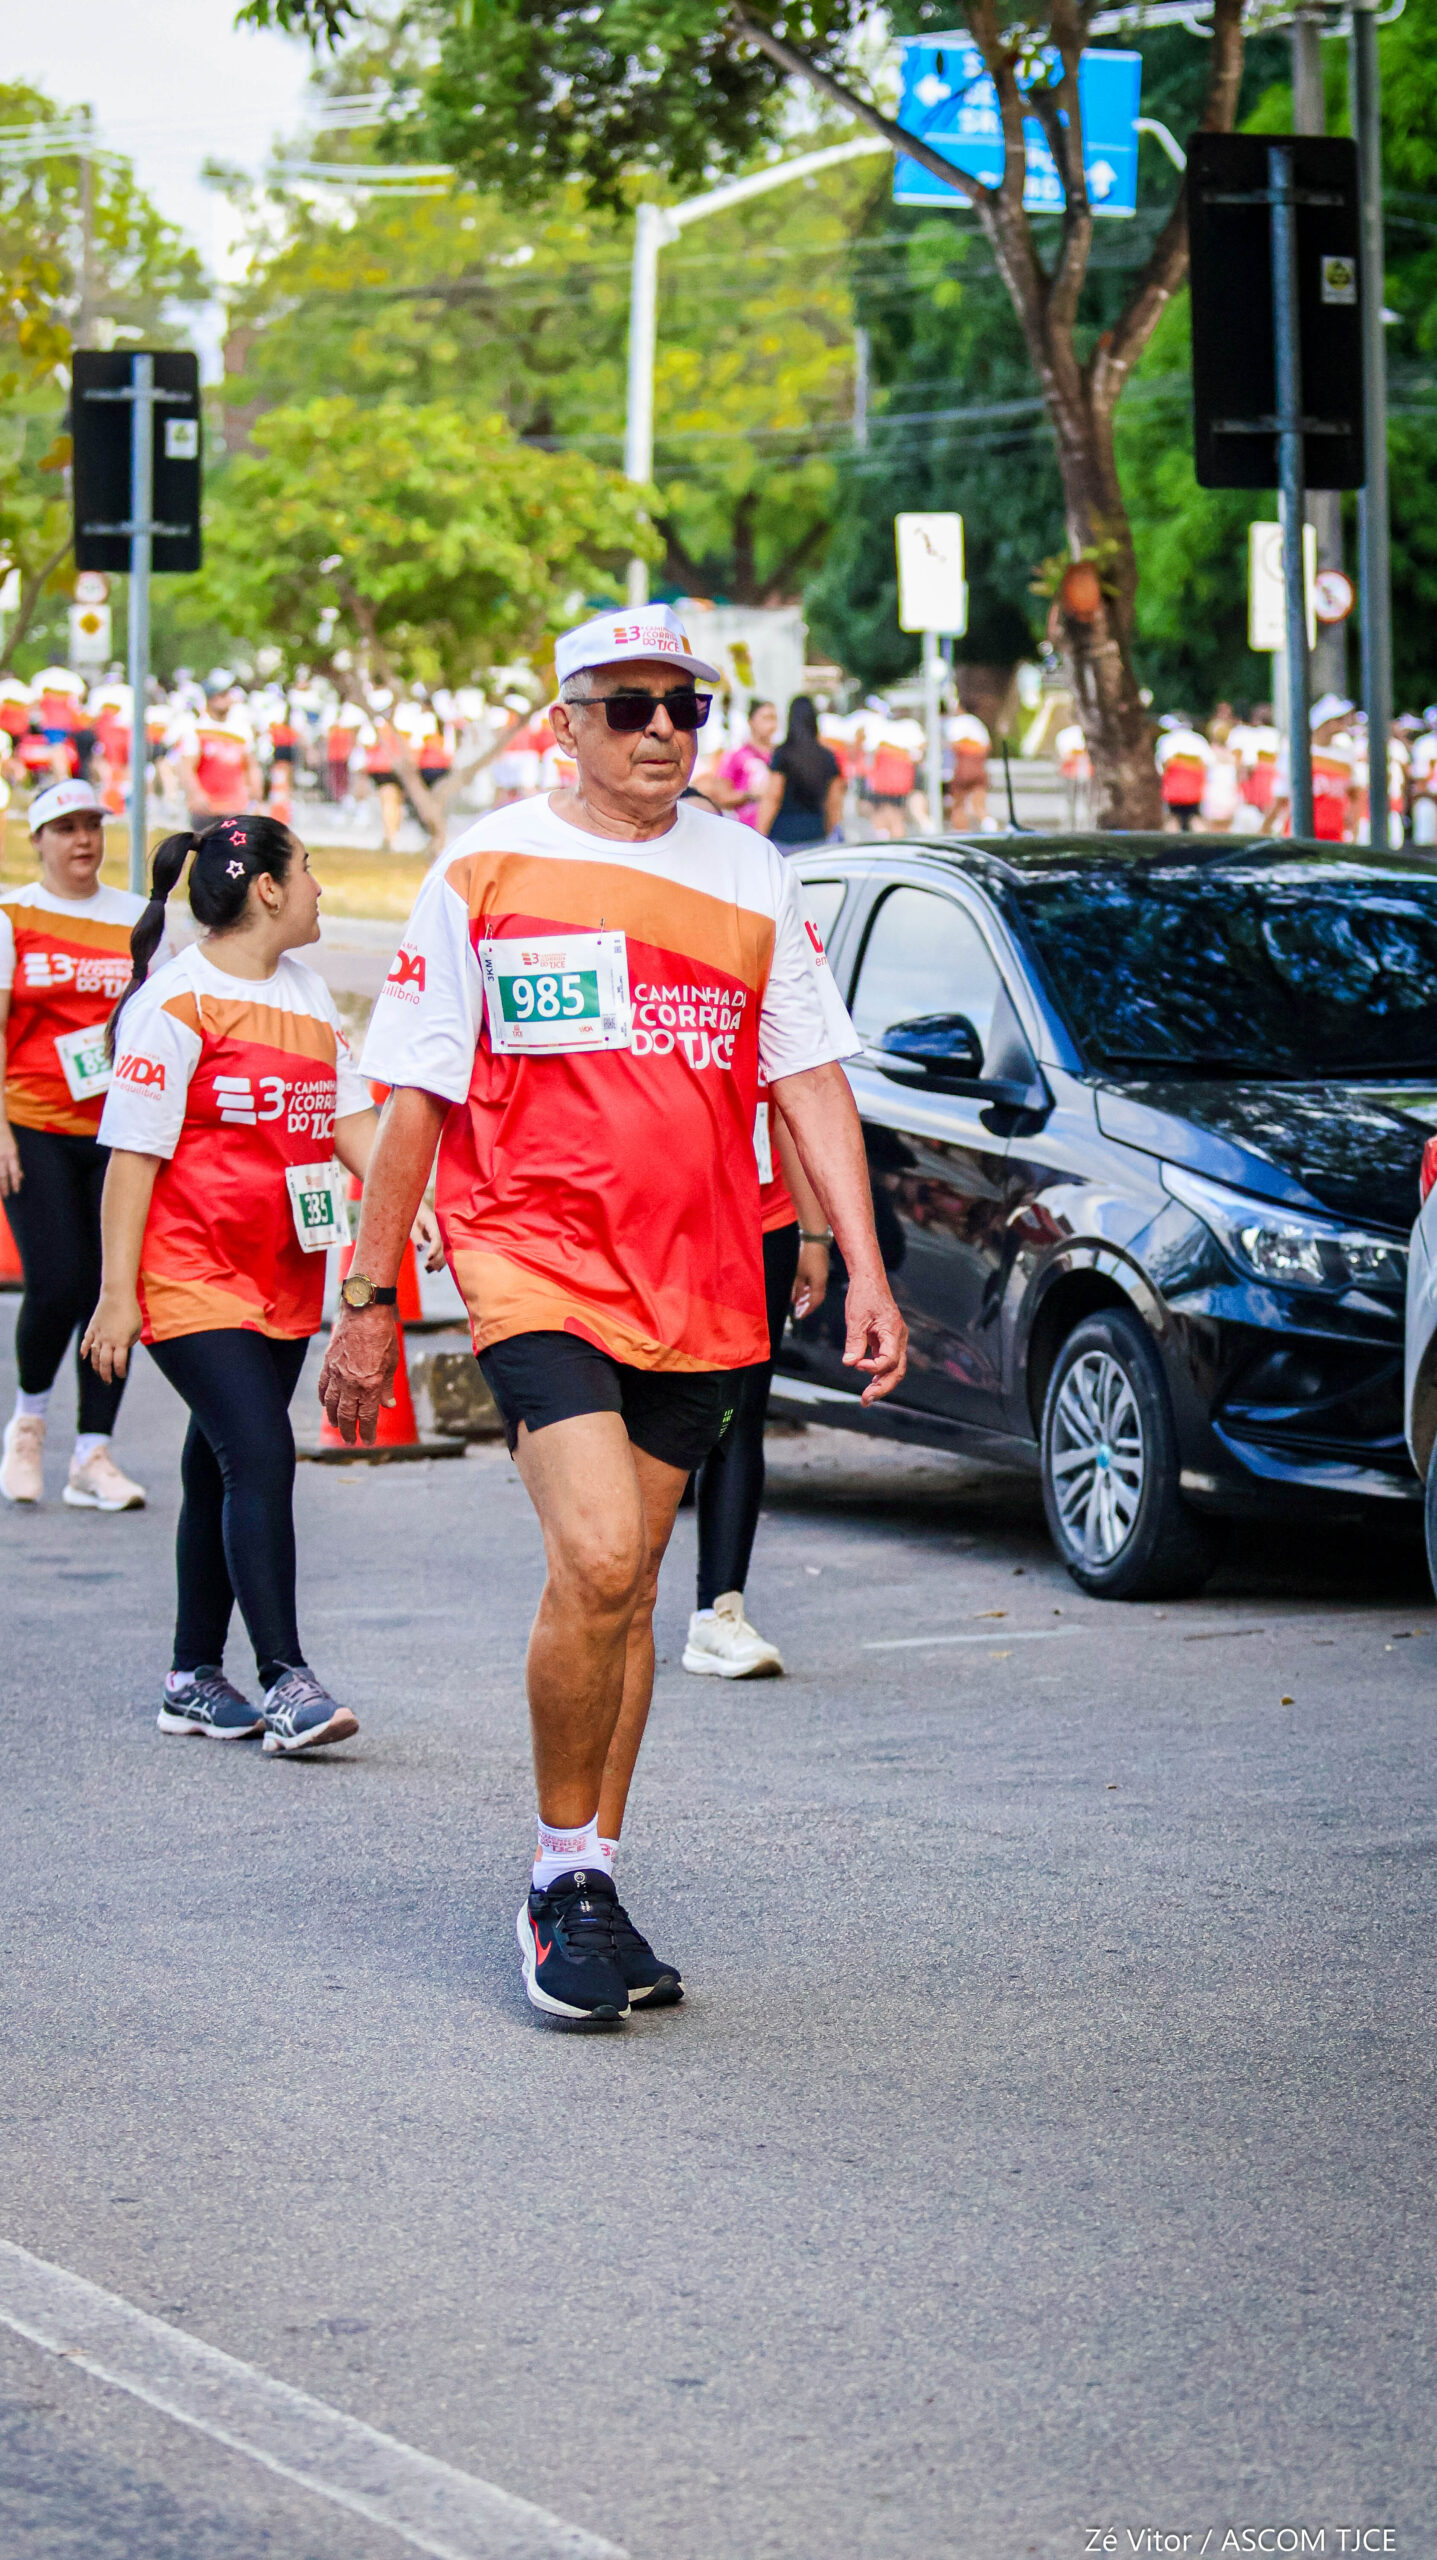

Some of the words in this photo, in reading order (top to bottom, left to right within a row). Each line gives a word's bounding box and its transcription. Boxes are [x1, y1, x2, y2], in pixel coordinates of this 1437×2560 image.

[657, 639, 680, 653] TJCE
[484, 959, 495, 982] 3KM
[512, 974, 585, 1019] 985
[634, 983, 747, 1009] CAMINHAD
[631, 1028, 675, 1056] DO
[676, 1031, 736, 1070] TJCE
[287, 1112, 309, 1133] DO
[311, 1112, 337, 1140] TJC
